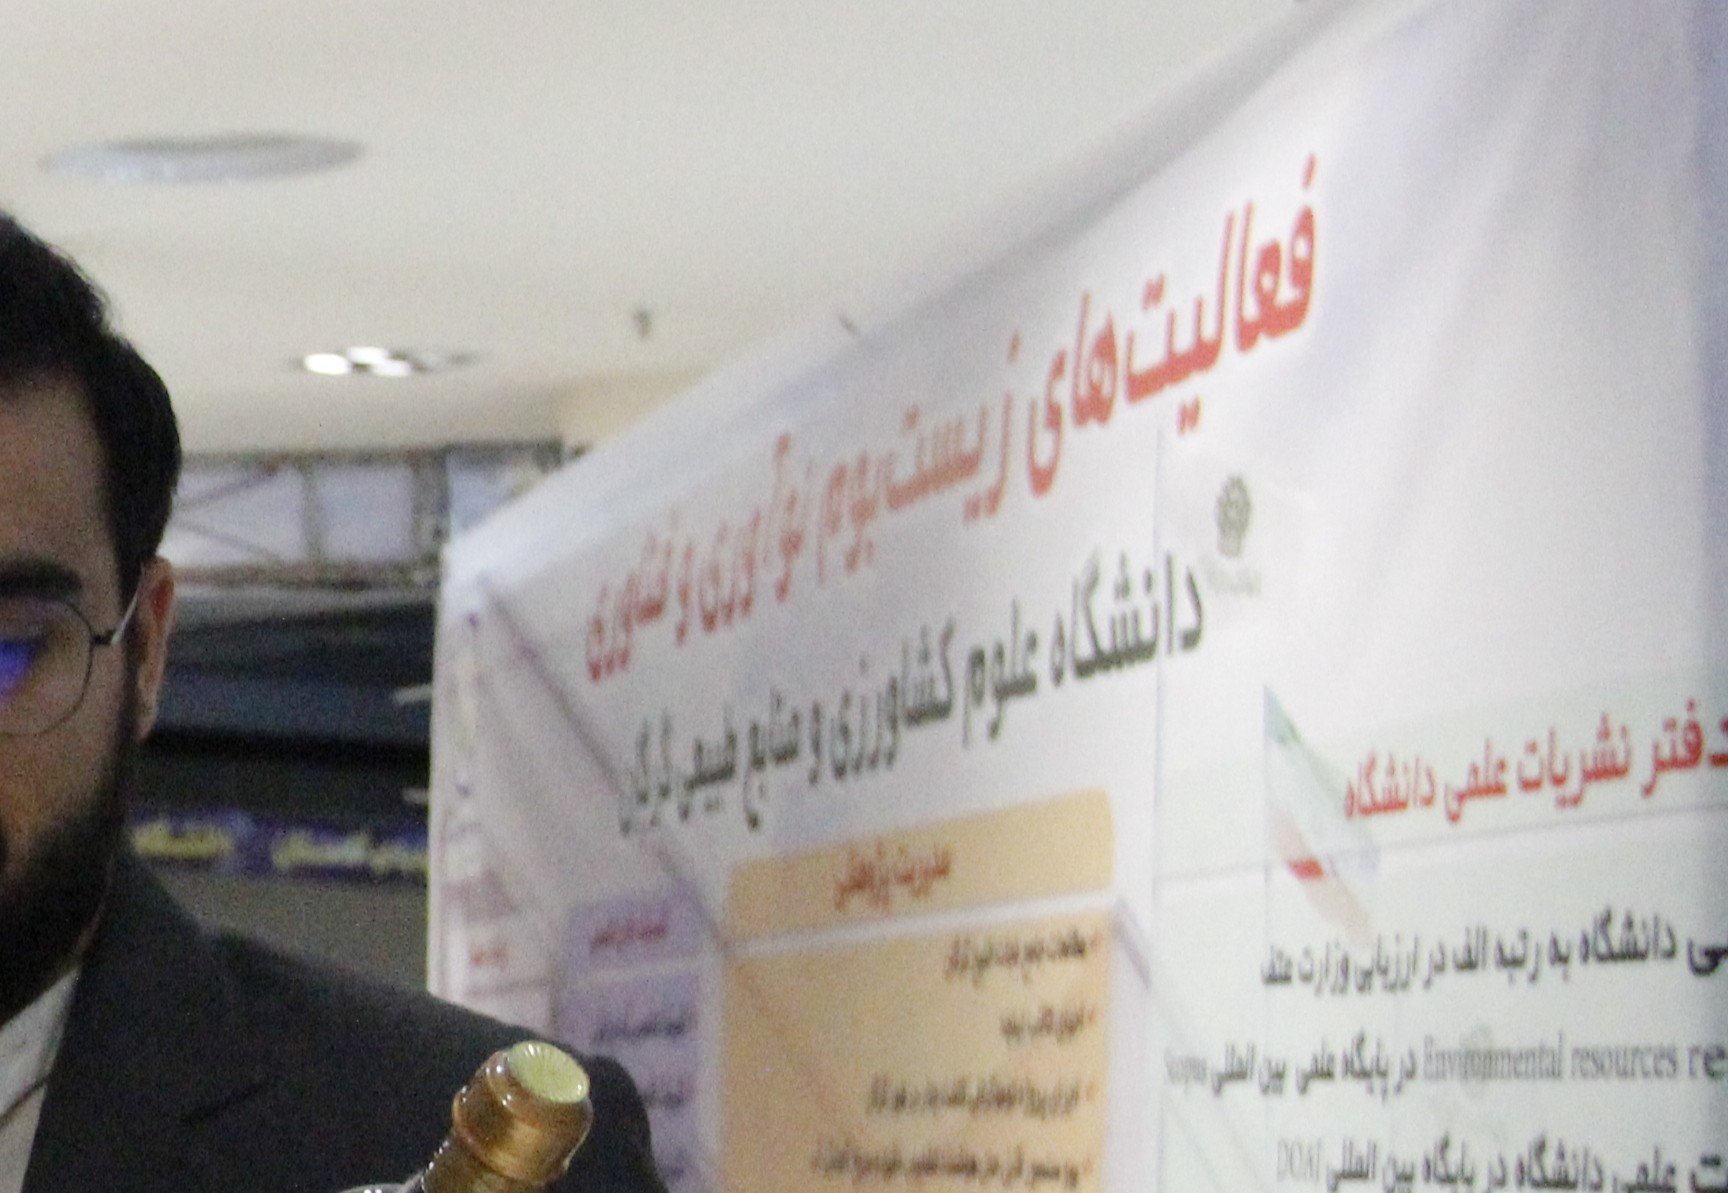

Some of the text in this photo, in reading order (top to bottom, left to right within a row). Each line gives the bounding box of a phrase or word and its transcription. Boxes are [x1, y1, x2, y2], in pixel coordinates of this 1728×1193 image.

[1050, 550, 1203, 688] دانشگاه
[830, 614, 956, 782] کشاورزی
[963, 598, 1038, 749] علوم
[745, 684, 801, 833] منابع
[808, 698, 823, 786] و
[1517, 711, 1631, 808] نشریات
[1345, 750, 1435, 819] دانشگاه
[1444, 738, 1509, 823] علمی
[1354, 933, 1419, 993] ارزیابی
[1423, 934, 1445, 991] در
[1453, 925, 1486, 972] الف
[1495, 928, 1540, 986] رتبه
[1549, 930, 1570, 982] به
[1580, 905, 1676, 964] دانشگاه
[1258, 1055, 1287, 1096] بین
[1296, 1037, 1335, 1096] علمی
[1342, 1028, 1389, 1104] پایگاه
[1394, 1043, 1417, 1096] در
[1571, 1043, 1677, 1080] resources
[1515, 1133, 1604, 1193] دانشگاه
